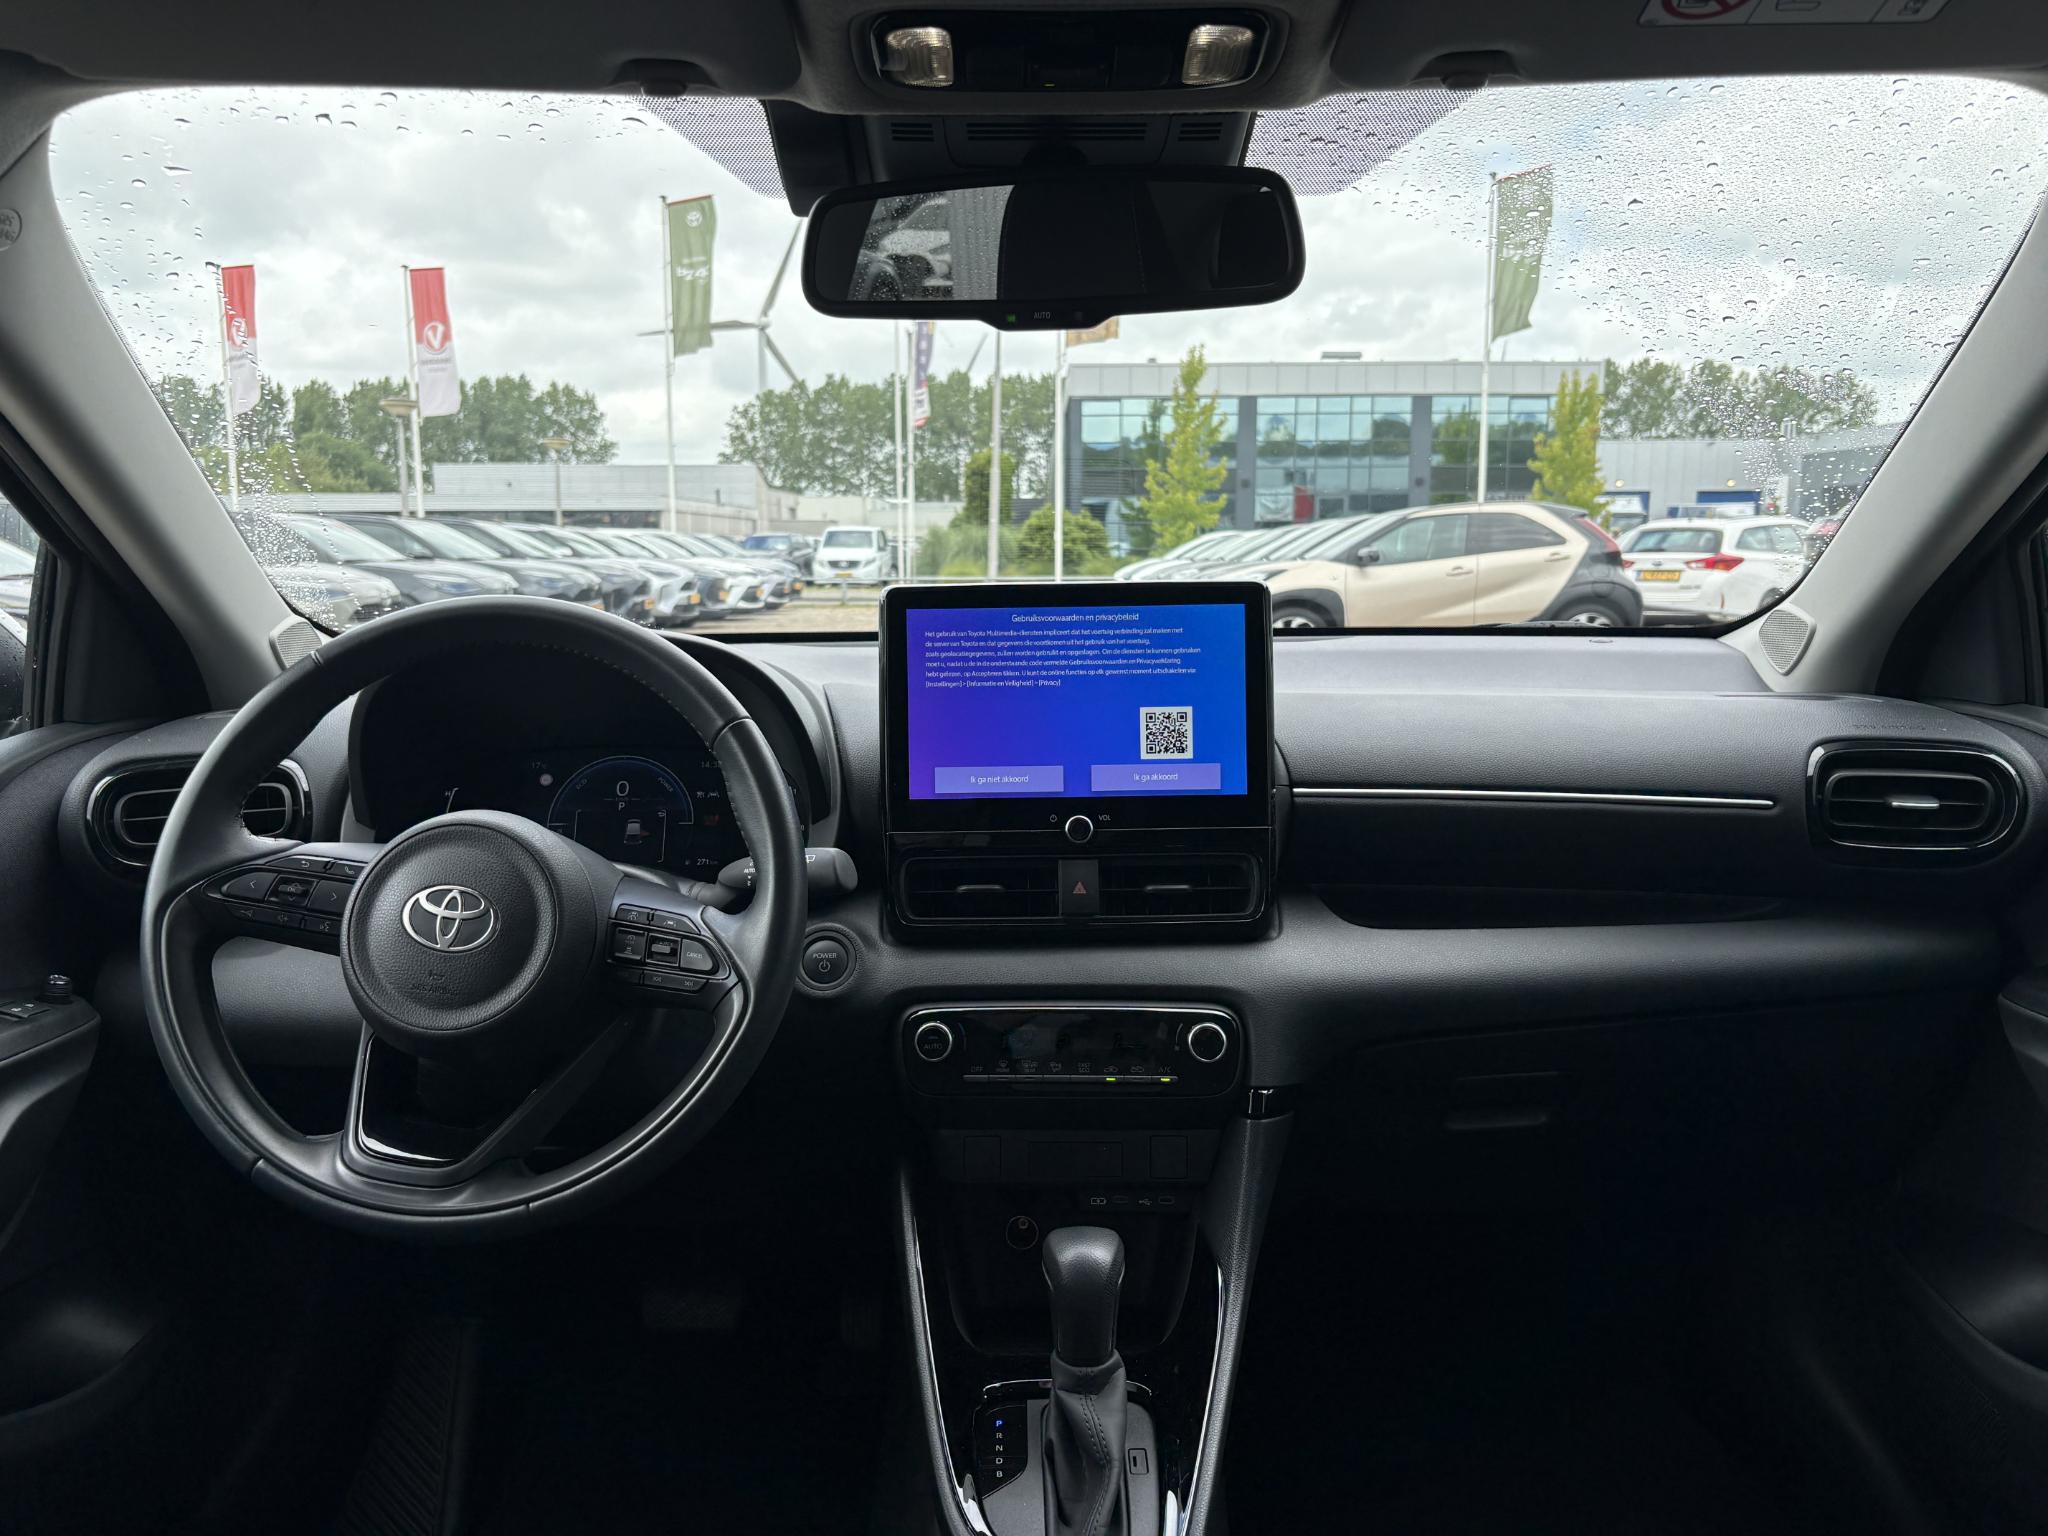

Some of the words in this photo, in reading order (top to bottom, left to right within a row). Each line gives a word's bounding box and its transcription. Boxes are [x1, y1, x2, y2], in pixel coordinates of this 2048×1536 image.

[1033, 311, 1051, 320] AUTO
[1011, 614, 1085, 622] Gebruiksvoorwaarden
[1095, 612, 1140, 622] privacybeleid
[968, 629, 986, 638] Toyota
[960, 640, 978, 648] Toyota
[970, 775, 976, 783] Ik
[1002, 775, 1029, 783] akkoord
[1134, 773, 1139, 781] Ik
[1140, 774, 1150, 783] ga
[1151, 773, 1178, 781] akkoord
[616, 780, 630, 798] 0
[618, 802, 626, 812] P
[1098, 814, 1112, 822] VOL
[696, 858, 709, 866] 271
[970, 1064, 984, 1073] OFF
